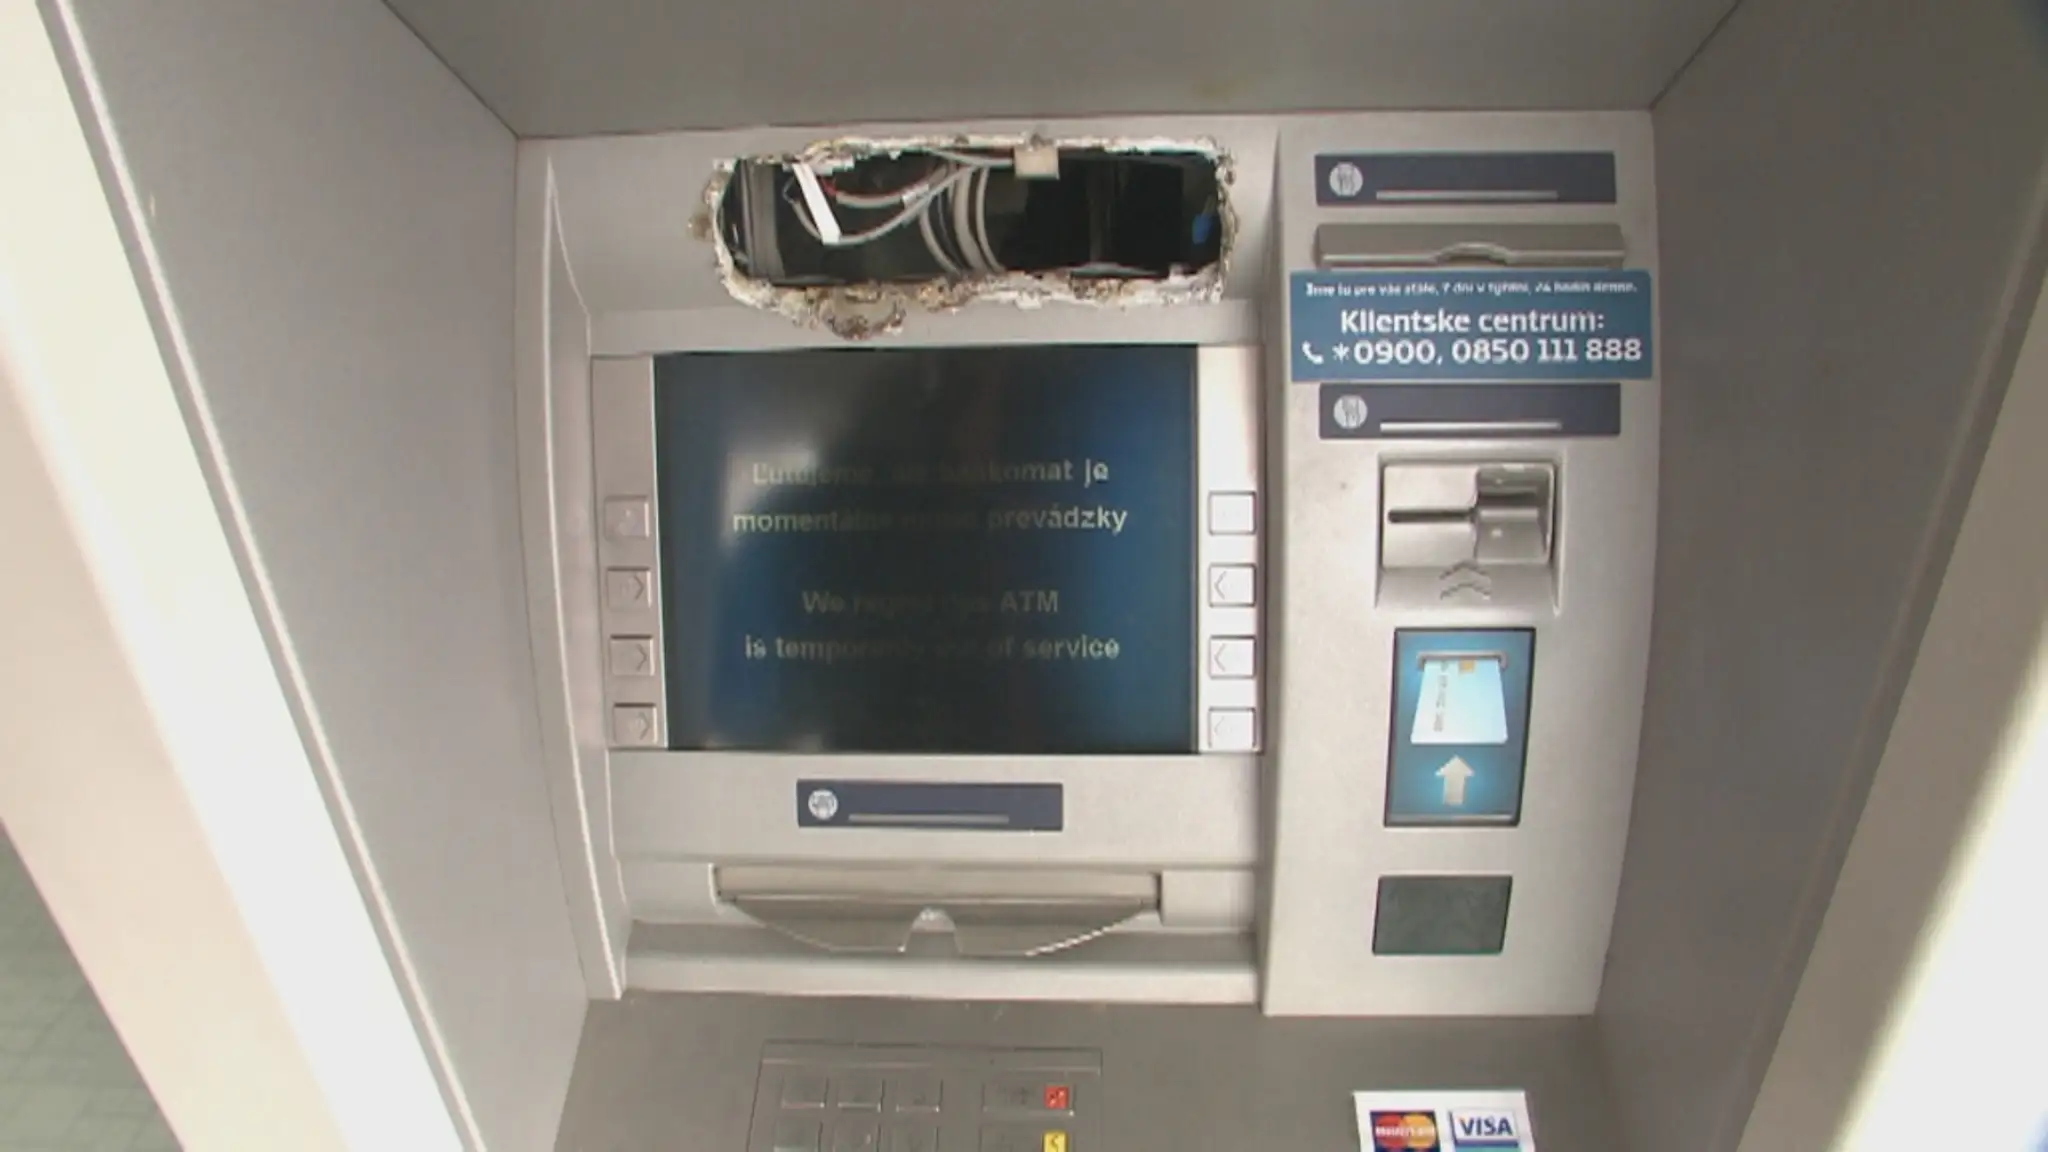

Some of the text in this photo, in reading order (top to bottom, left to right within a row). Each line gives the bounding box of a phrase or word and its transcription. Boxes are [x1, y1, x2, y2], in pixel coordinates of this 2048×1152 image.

[1340, 308, 1605, 334] Klientske centrum:
[1451, 337, 1530, 365] 0850
[1536, 337, 1578, 363] 111
[1584, 337, 1643, 362] 888
[938, 459, 1073, 483] bkomat
[1083, 457, 1110, 489] je
[1000, 589, 1060, 613] ATM
[1021, 634, 1121, 660] service
[1458, 1116, 1513, 1137] VISA
